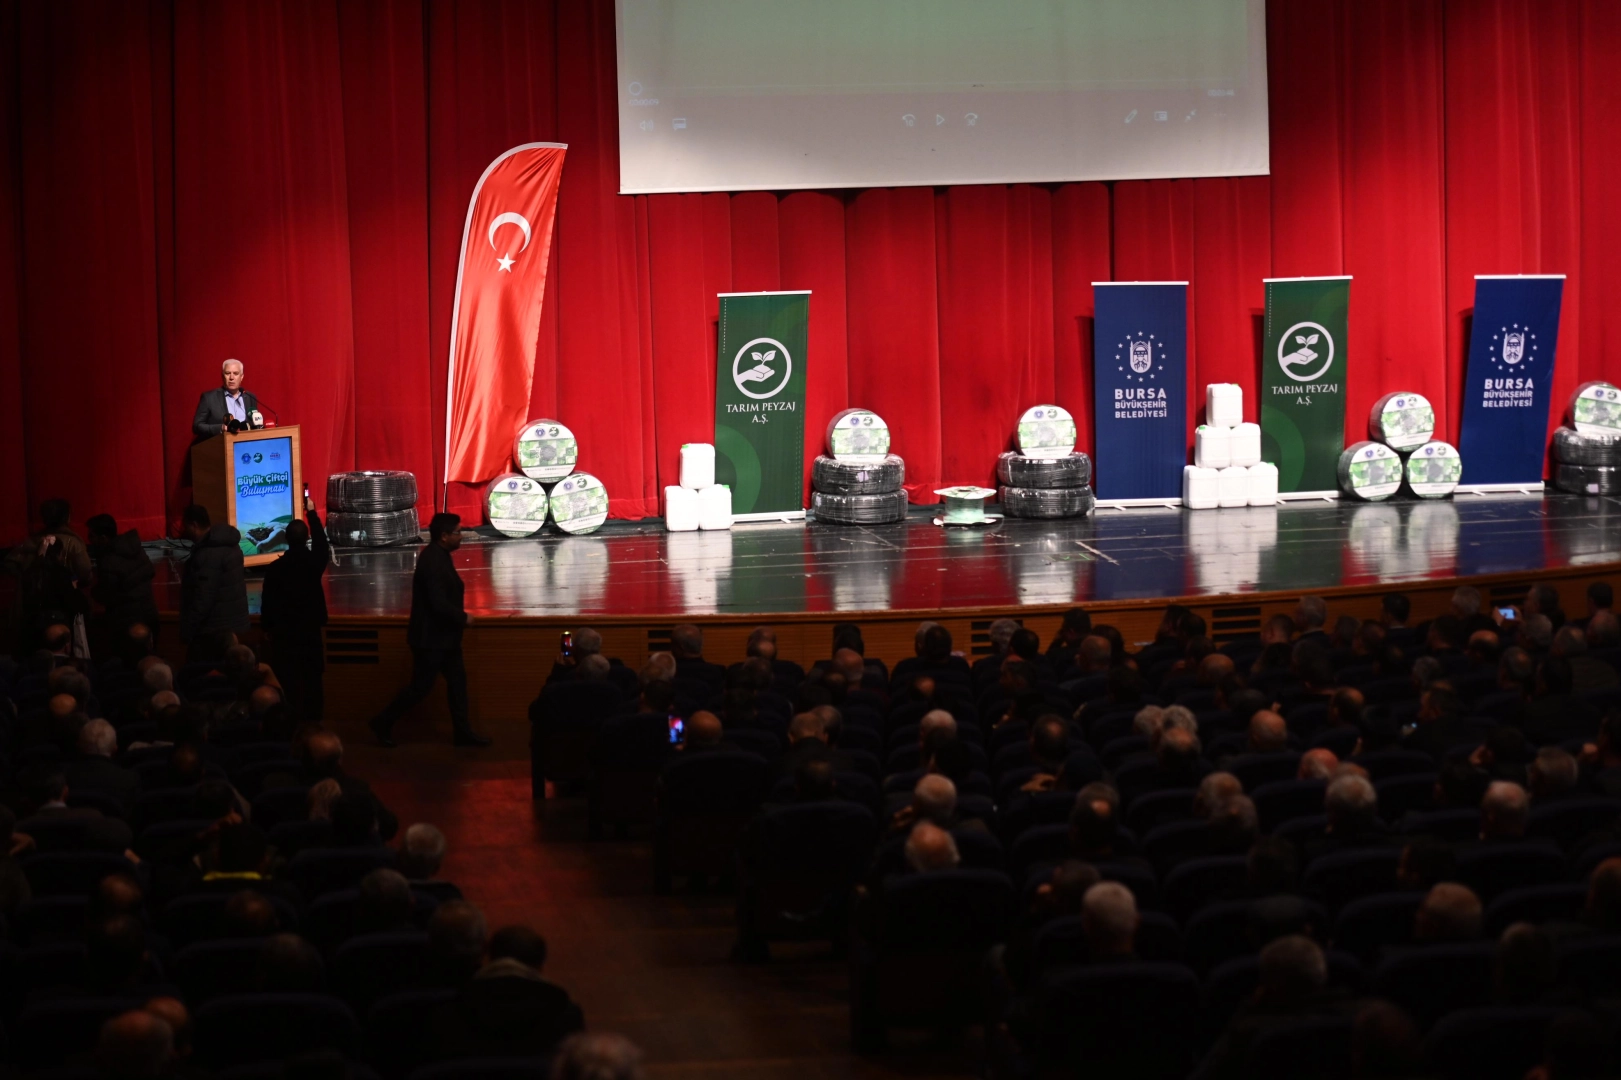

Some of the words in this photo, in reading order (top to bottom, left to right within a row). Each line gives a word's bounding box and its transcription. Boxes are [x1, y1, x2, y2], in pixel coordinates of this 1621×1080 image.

[1271, 385, 1304, 395] TARIM
[1305, 383, 1338, 394] PEYZAJ
[1484, 378, 1534, 389] BURSA
[1114, 388, 1167, 400] BURSA
[1483, 389, 1533, 399] BÜYÜKŞEHİR
[725, 403, 760, 413] TARIM
[762, 401, 796, 412] PEYZAJ
[1114, 399, 1167, 409] BÜYÜKŞEHİR
[1482, 397, 1533, 408] BELEDİYESİ
[751, 413, 769, 425] A.Ş.
[1114, 408, 1167, 418] BELEDİYESİ
[237, 475, 264, 487] Büyük
[265, 472, 288, 484] Çiftçi
[241, 485, 286, 497] Buluşması
